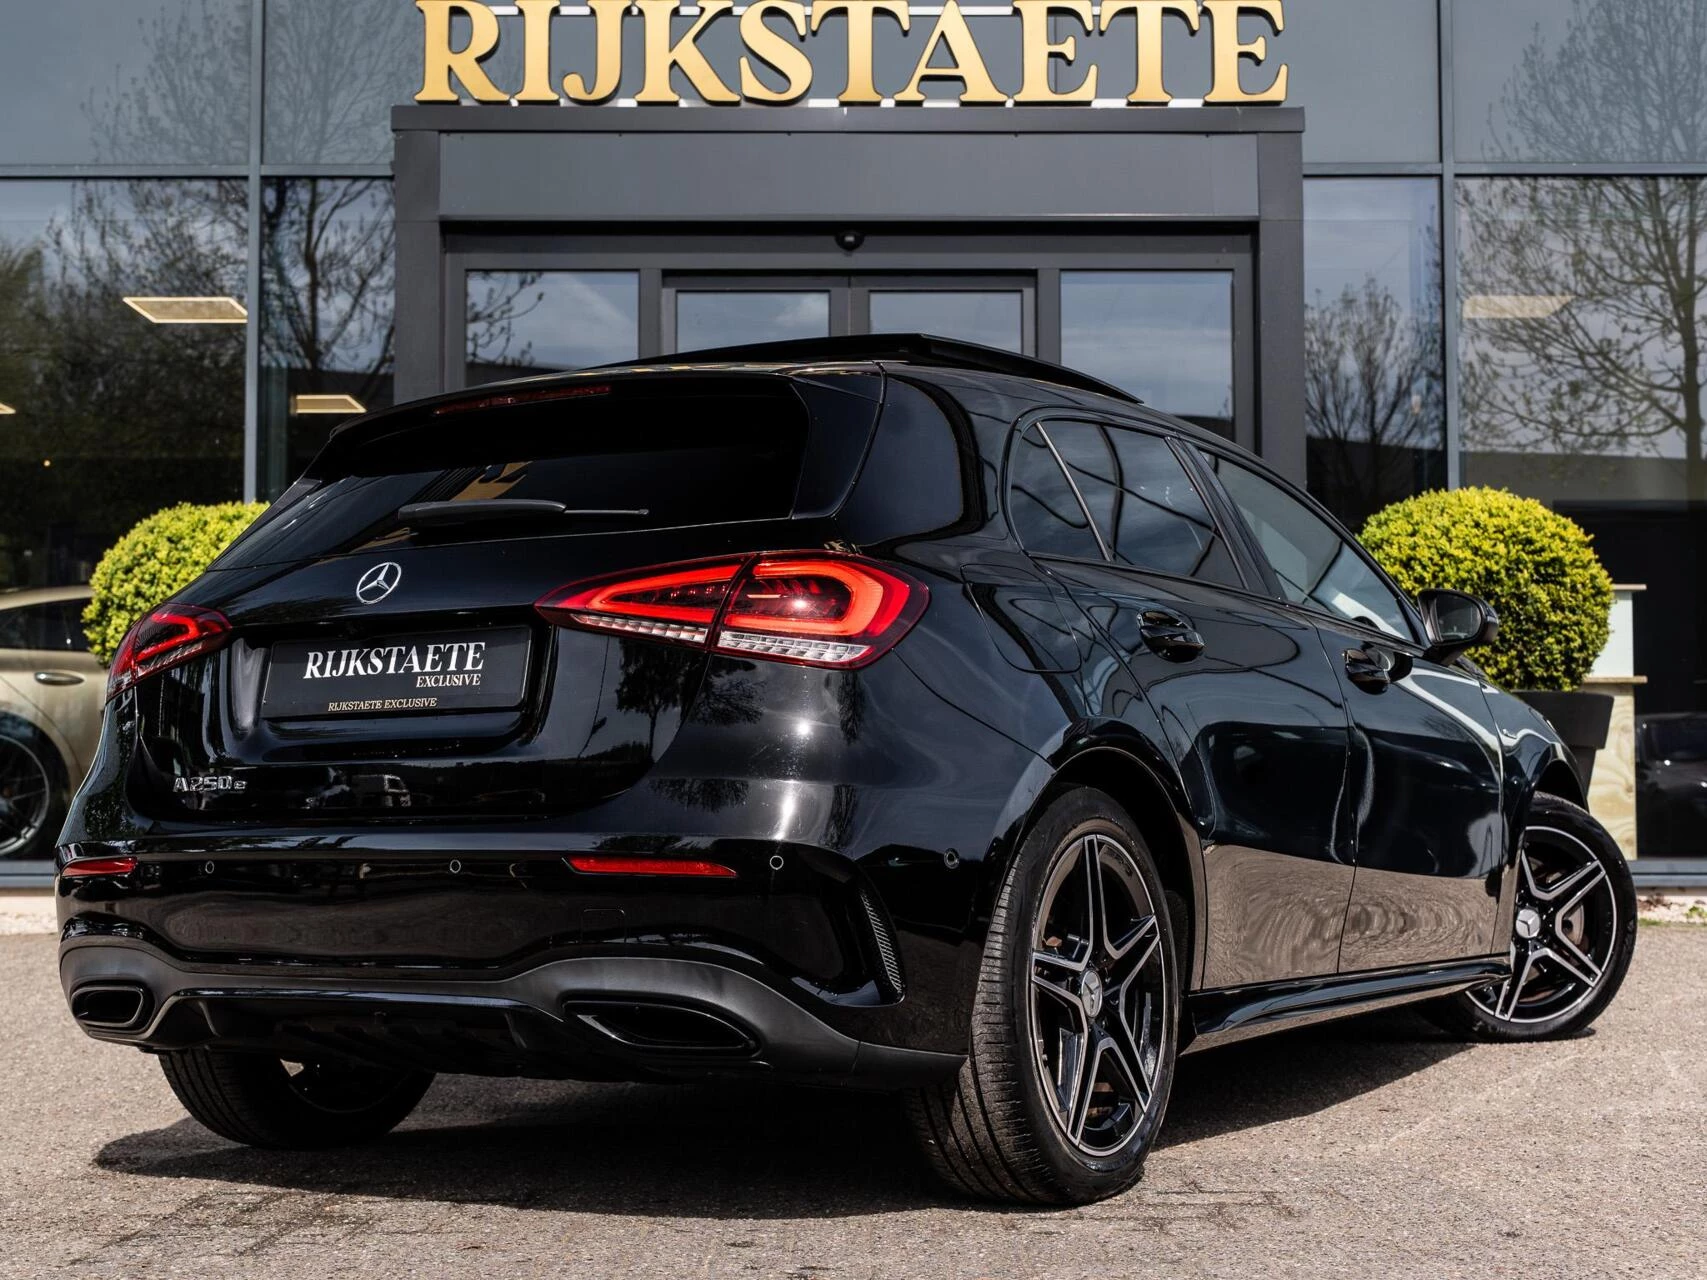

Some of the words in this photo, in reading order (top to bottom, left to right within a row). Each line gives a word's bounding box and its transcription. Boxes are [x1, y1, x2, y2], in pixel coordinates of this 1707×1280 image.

[414, 0, 1287, 106] RIJKSTAETE
[303, 642, 486, 679] RIJKSTAETE
[416, 673, 481, 688] EXCLUSIVE
[327, 700, 382, 712] RIJKSTAETE
[384, 698, 438, 709] EXCLUSIVE
